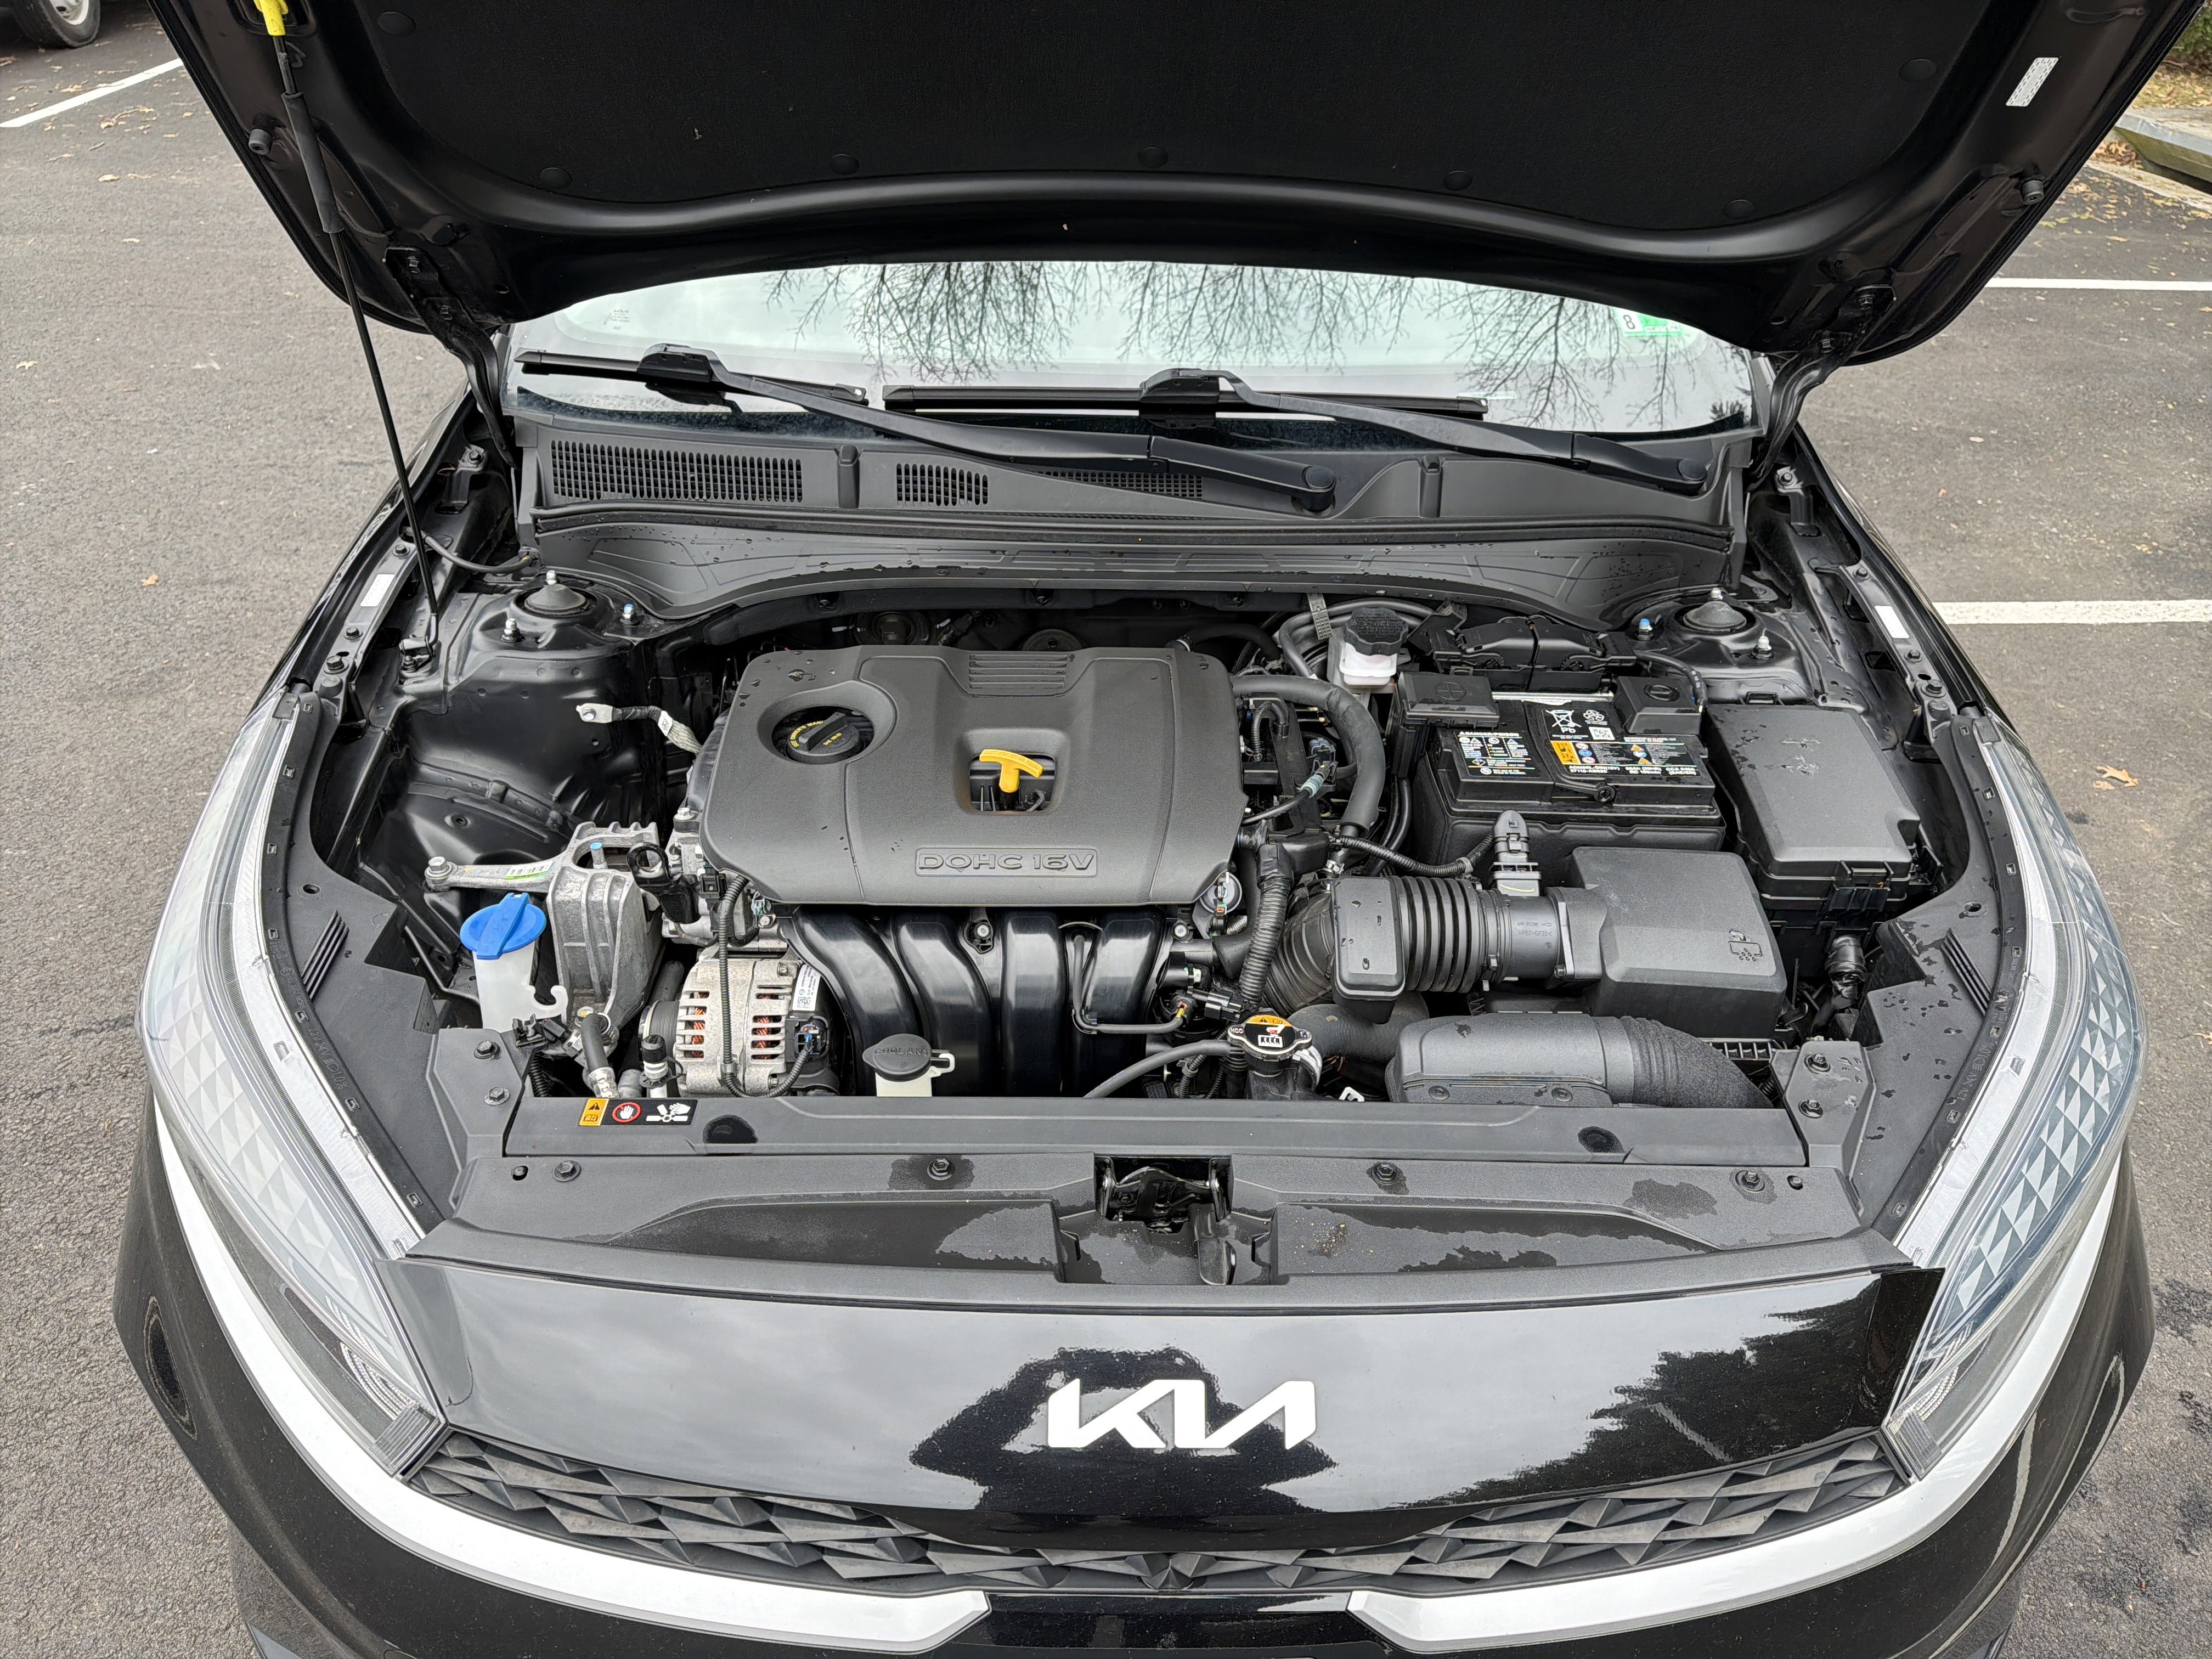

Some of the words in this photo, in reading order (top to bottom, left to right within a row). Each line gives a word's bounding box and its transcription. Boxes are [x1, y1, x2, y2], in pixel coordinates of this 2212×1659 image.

[1623, 315, 1635, 329] 8
[918, 854, 1023, 870] DOHC
[1032, 854, 1094, 870] 16V
[874, 1047, 930, 1057] COOLANT
[1048, 1378, 1316, 1449] KIA
